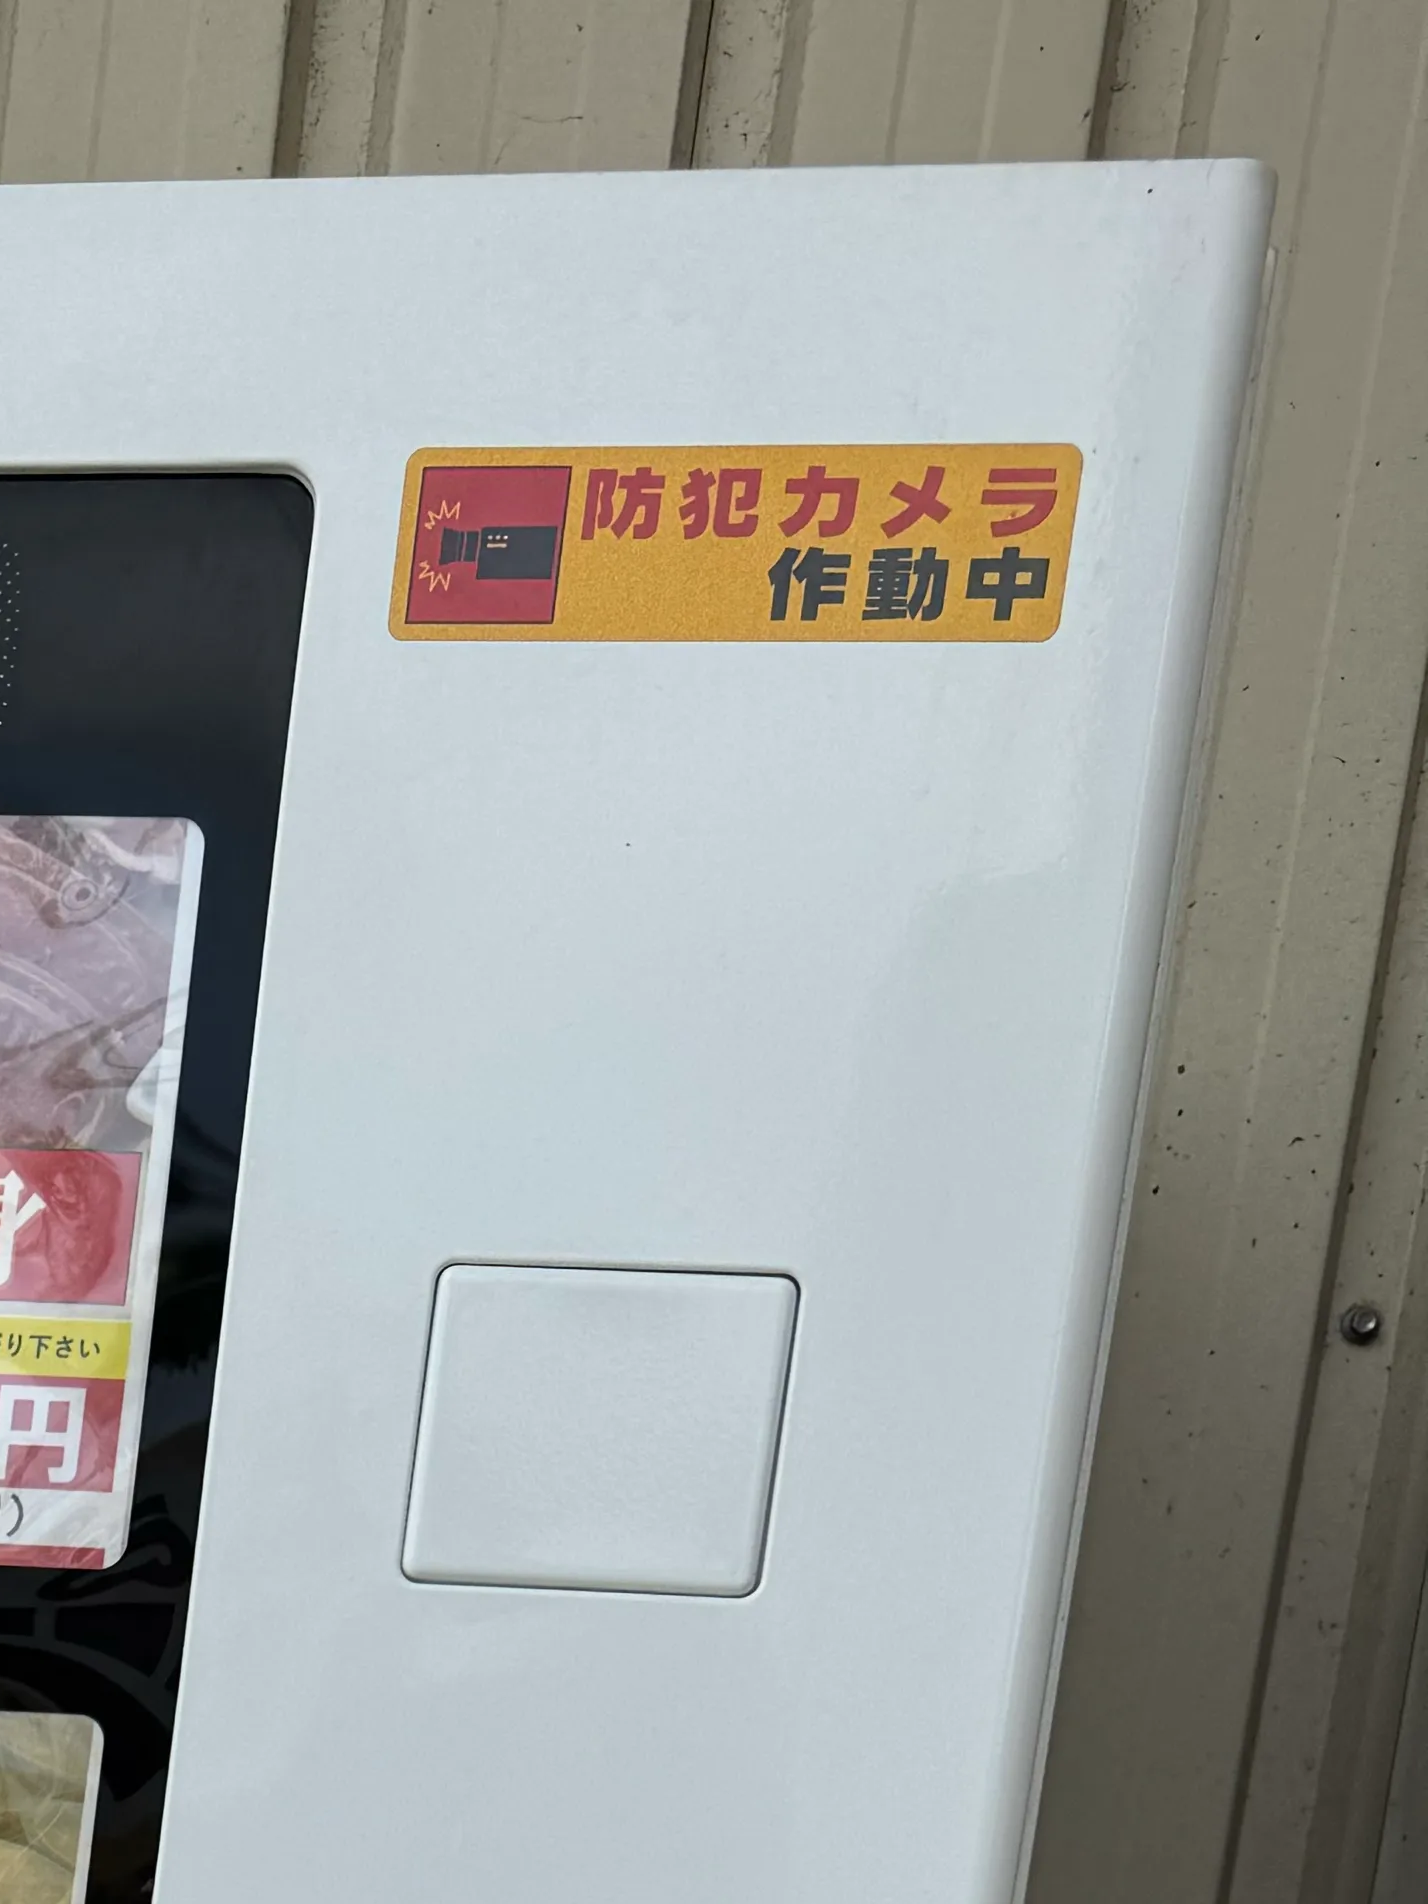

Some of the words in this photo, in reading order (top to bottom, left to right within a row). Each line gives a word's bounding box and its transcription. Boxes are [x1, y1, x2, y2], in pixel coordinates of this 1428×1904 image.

[581, 466, 1058, 540] 防犯カメラ
[768, 547, 1049, 622] 作動中
